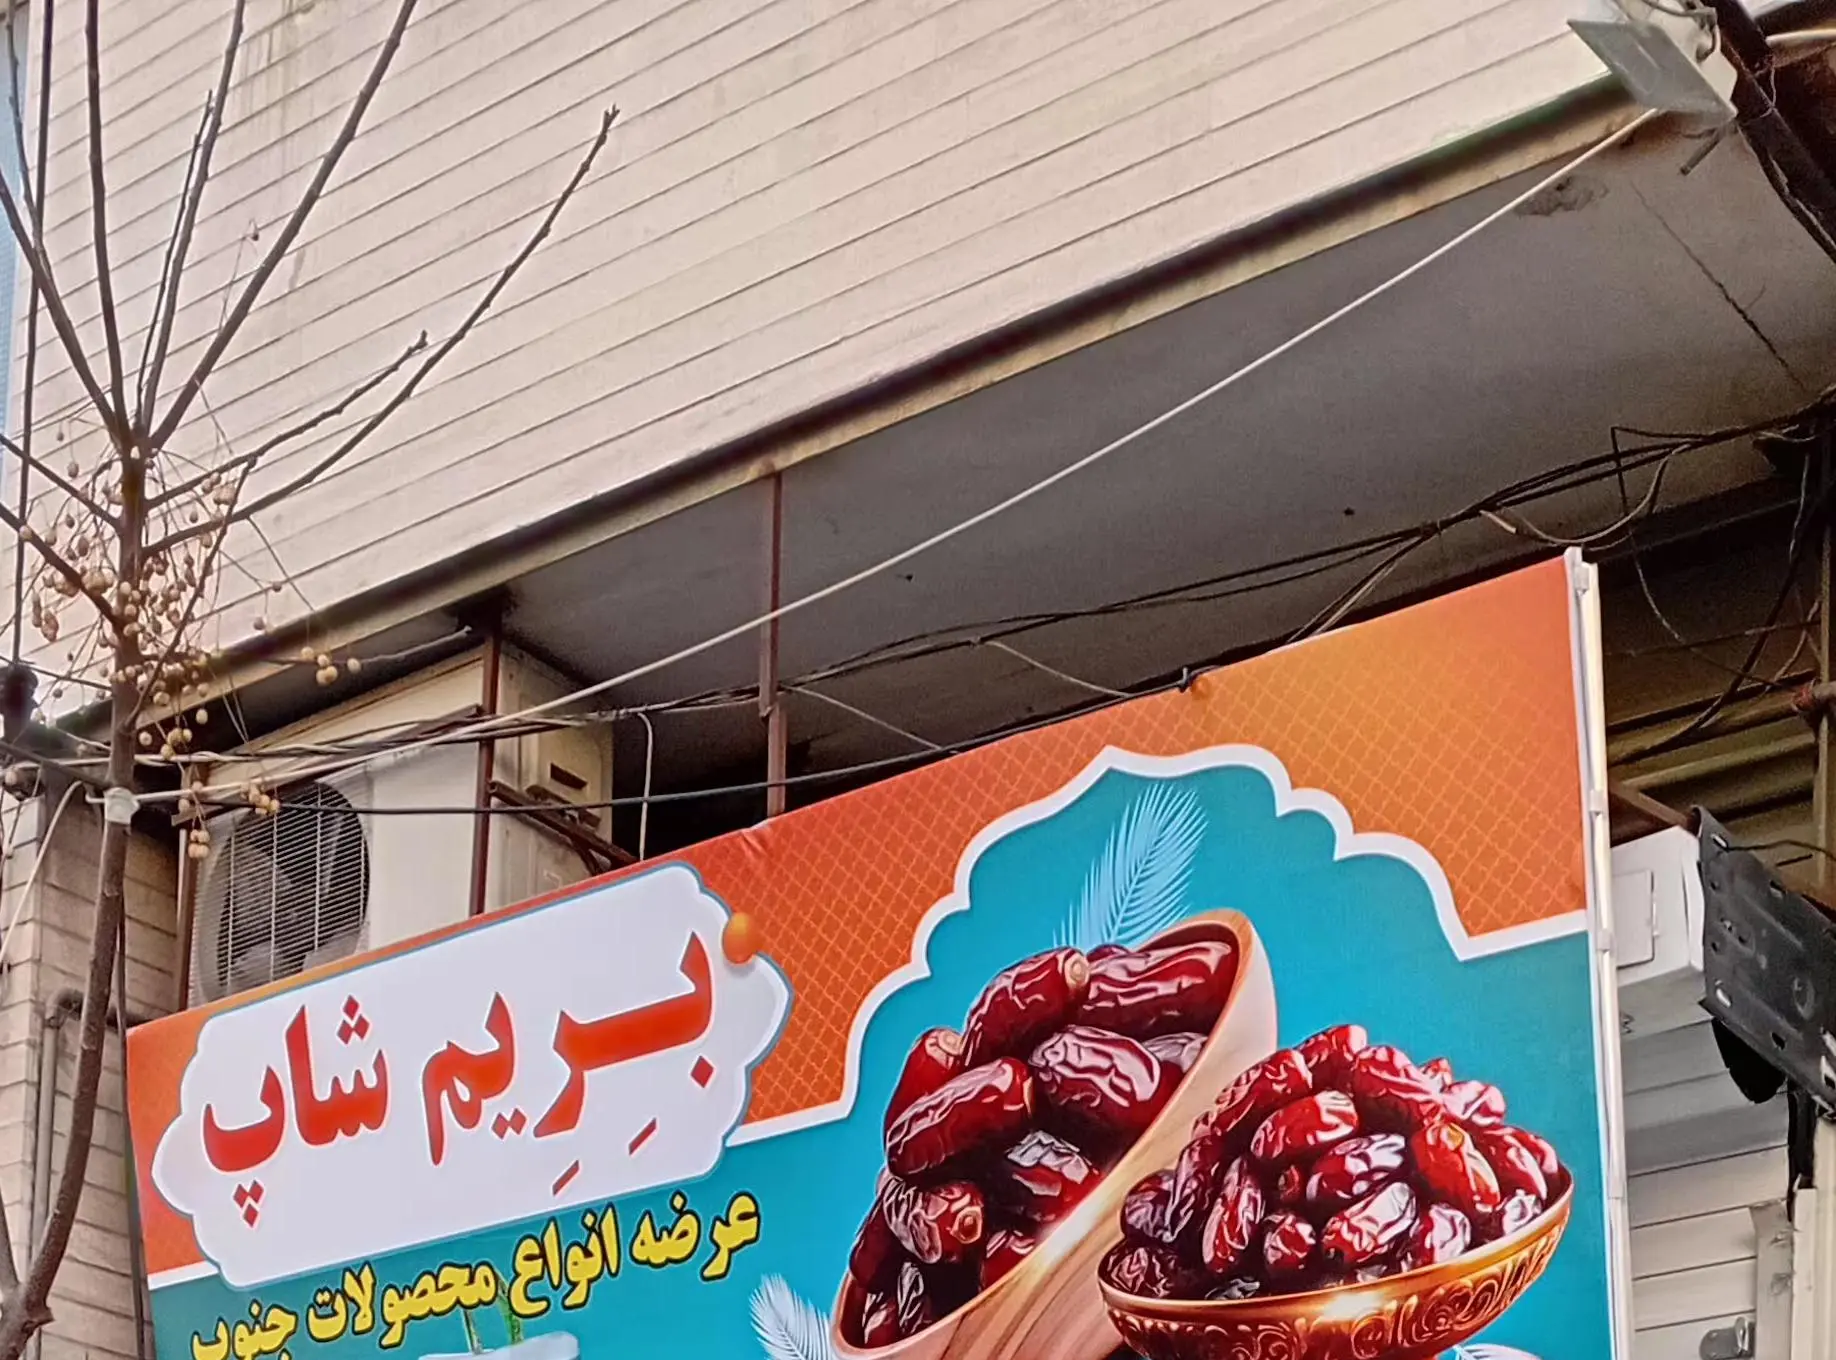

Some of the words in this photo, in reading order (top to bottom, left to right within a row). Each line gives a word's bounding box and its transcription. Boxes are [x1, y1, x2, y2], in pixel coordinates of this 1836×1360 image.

[202, 994, 391, 1230] شاپ
[507, 1203, 620, 1319] انواع
[630, 1189, 761, 1288] عرضه
[306, 1259, 500, 1350] محصولات
